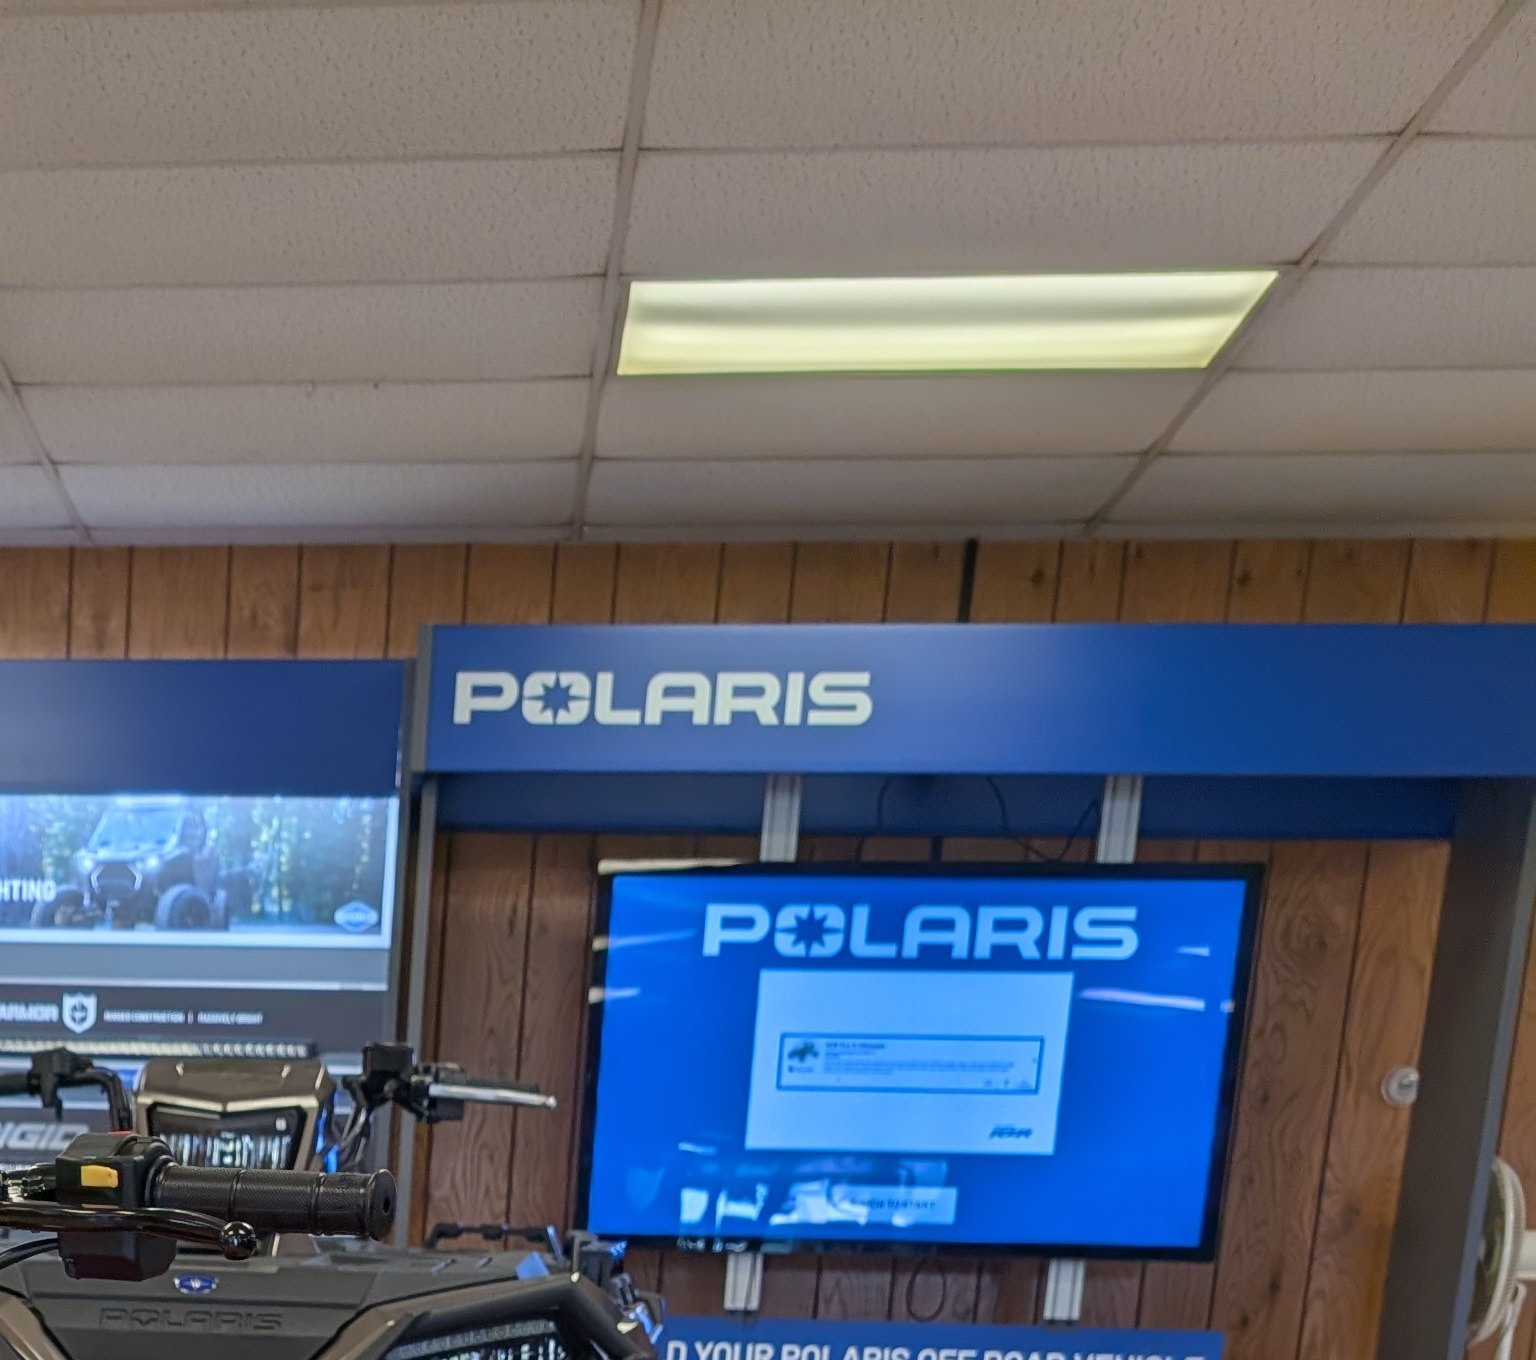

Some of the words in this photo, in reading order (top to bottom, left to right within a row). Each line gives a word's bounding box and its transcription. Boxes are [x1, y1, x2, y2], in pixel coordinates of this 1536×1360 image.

[453, 671, 873, 726] POLARIS
[703, 904, 1139, 960] POLARIS
[99, 1307, 281, 1330] POLARIS
